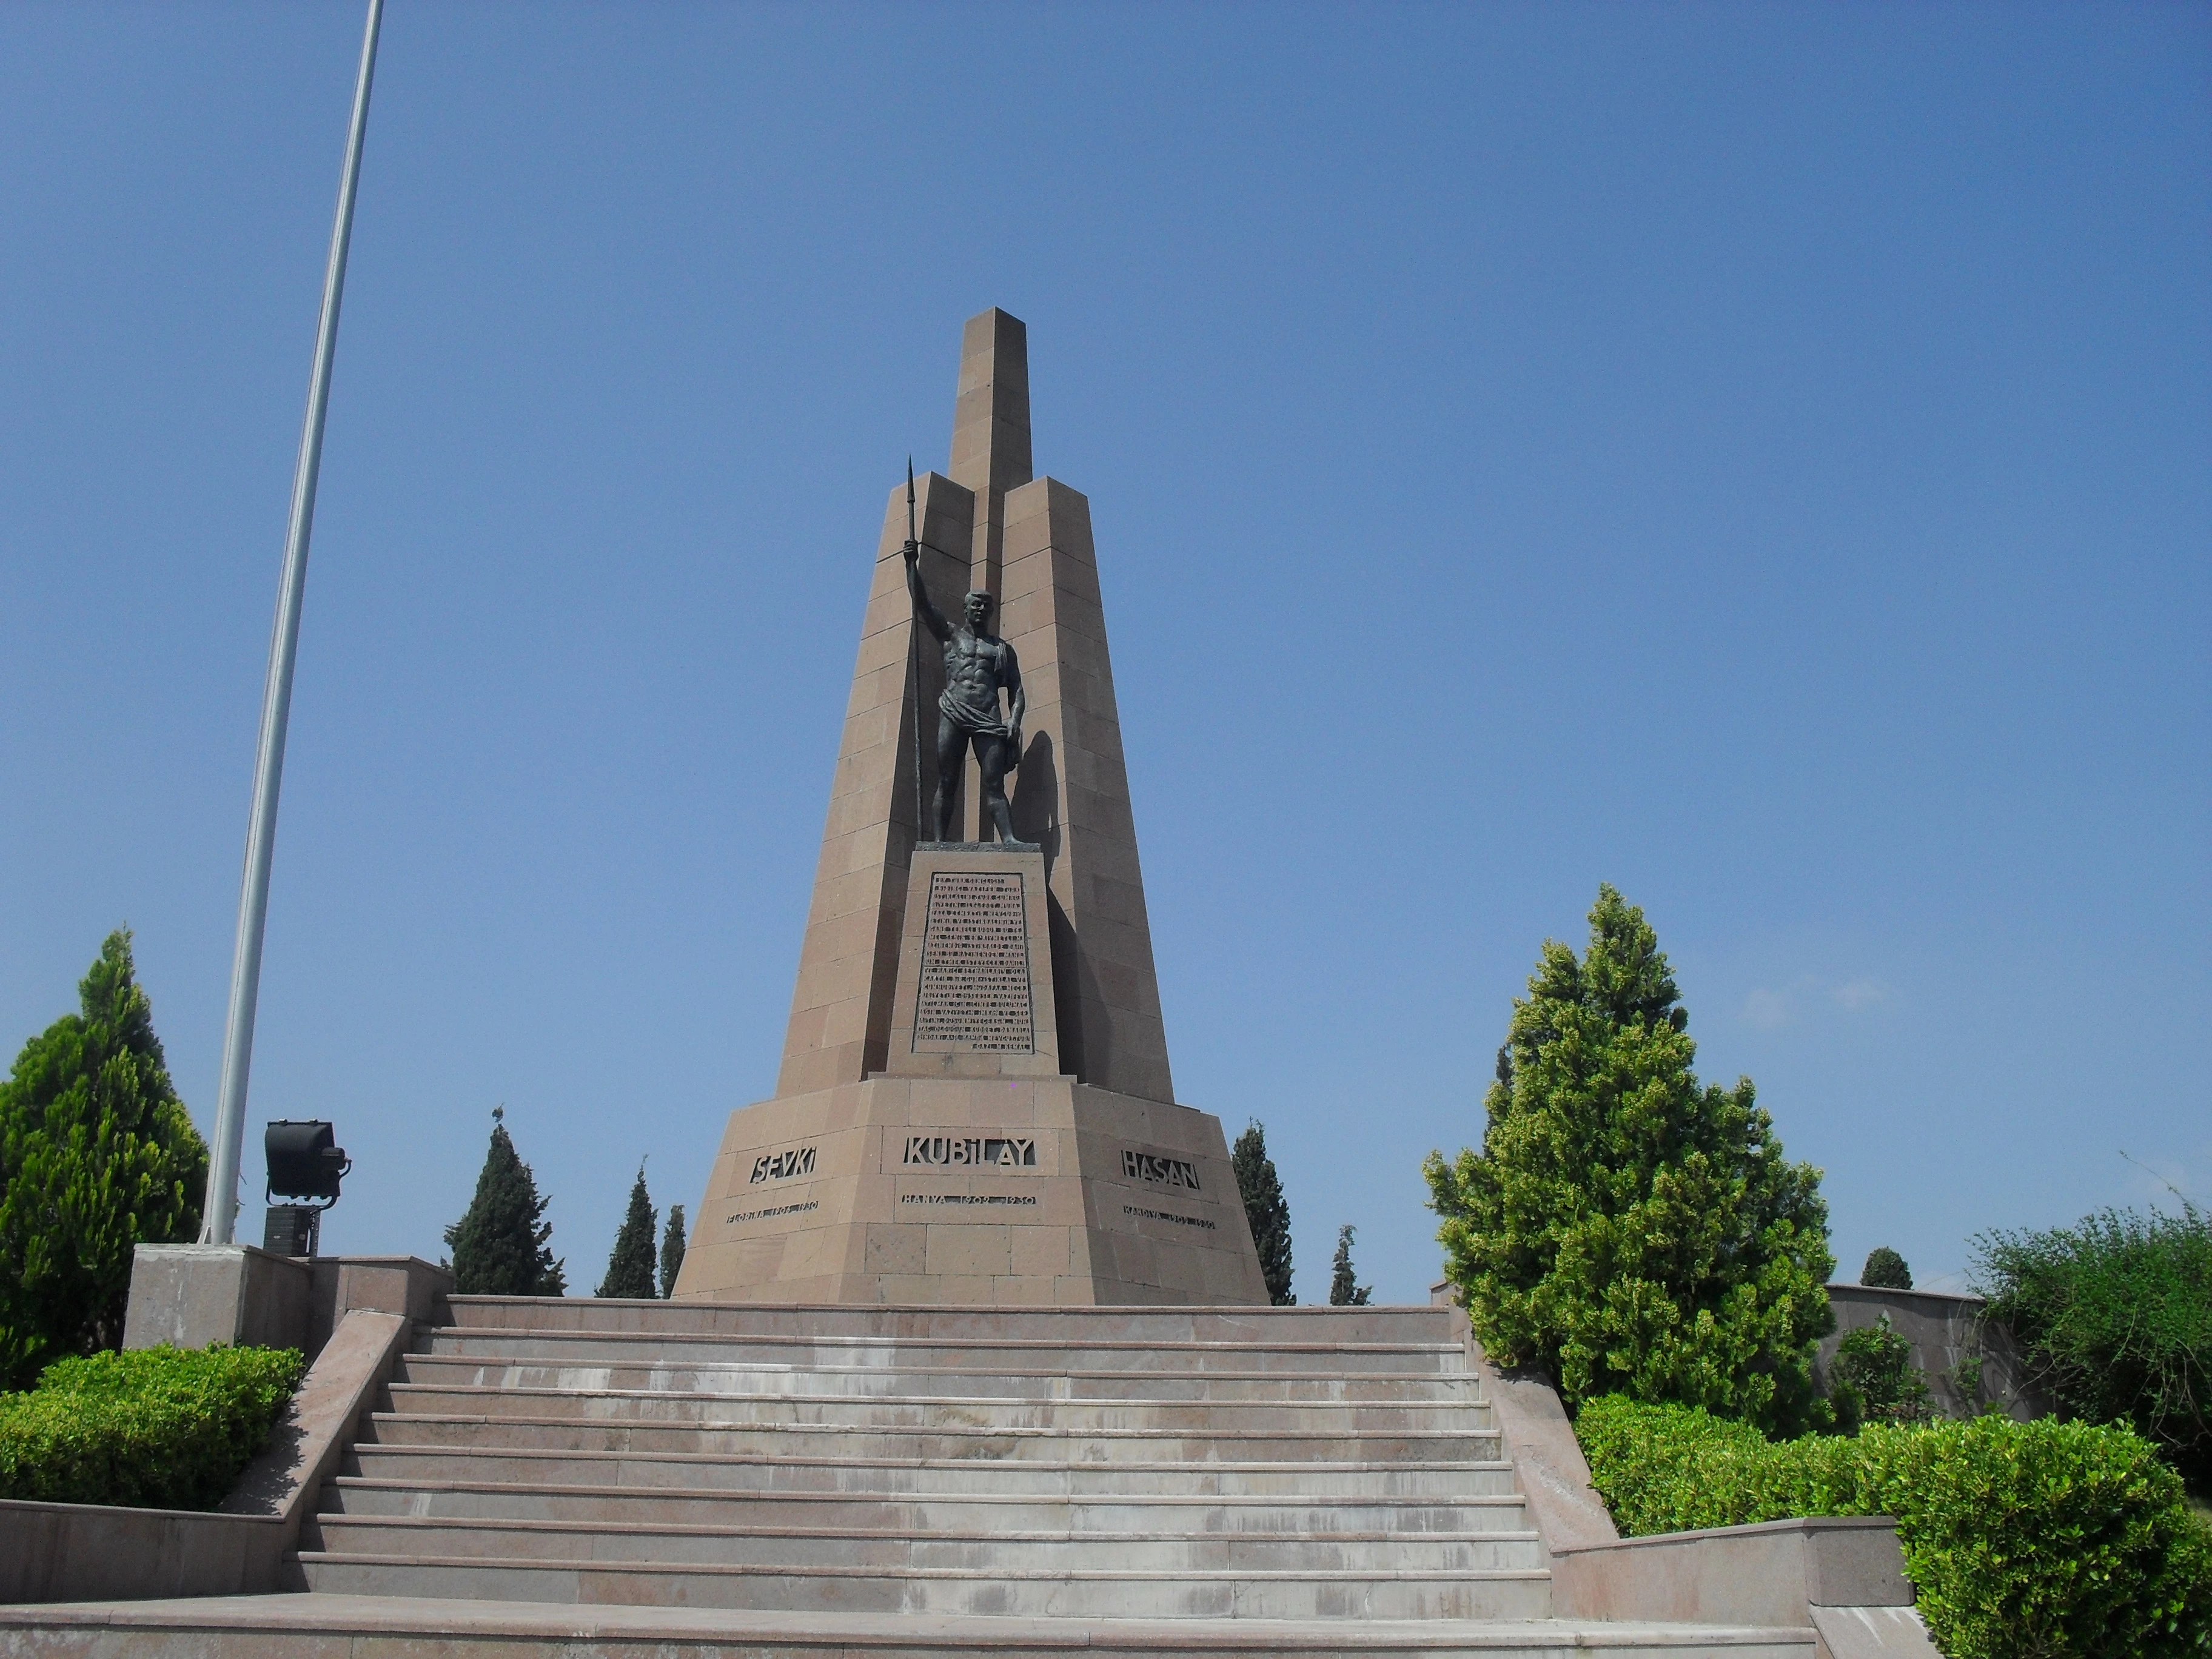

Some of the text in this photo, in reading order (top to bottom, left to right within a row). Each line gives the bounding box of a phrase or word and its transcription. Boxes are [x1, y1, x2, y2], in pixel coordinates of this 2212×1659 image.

[1122, 1150, 1199, 1189] HASAN
[902, 1195, 946, 1204] HANYA
[1006, 1196, 1035, 1205] 1930
